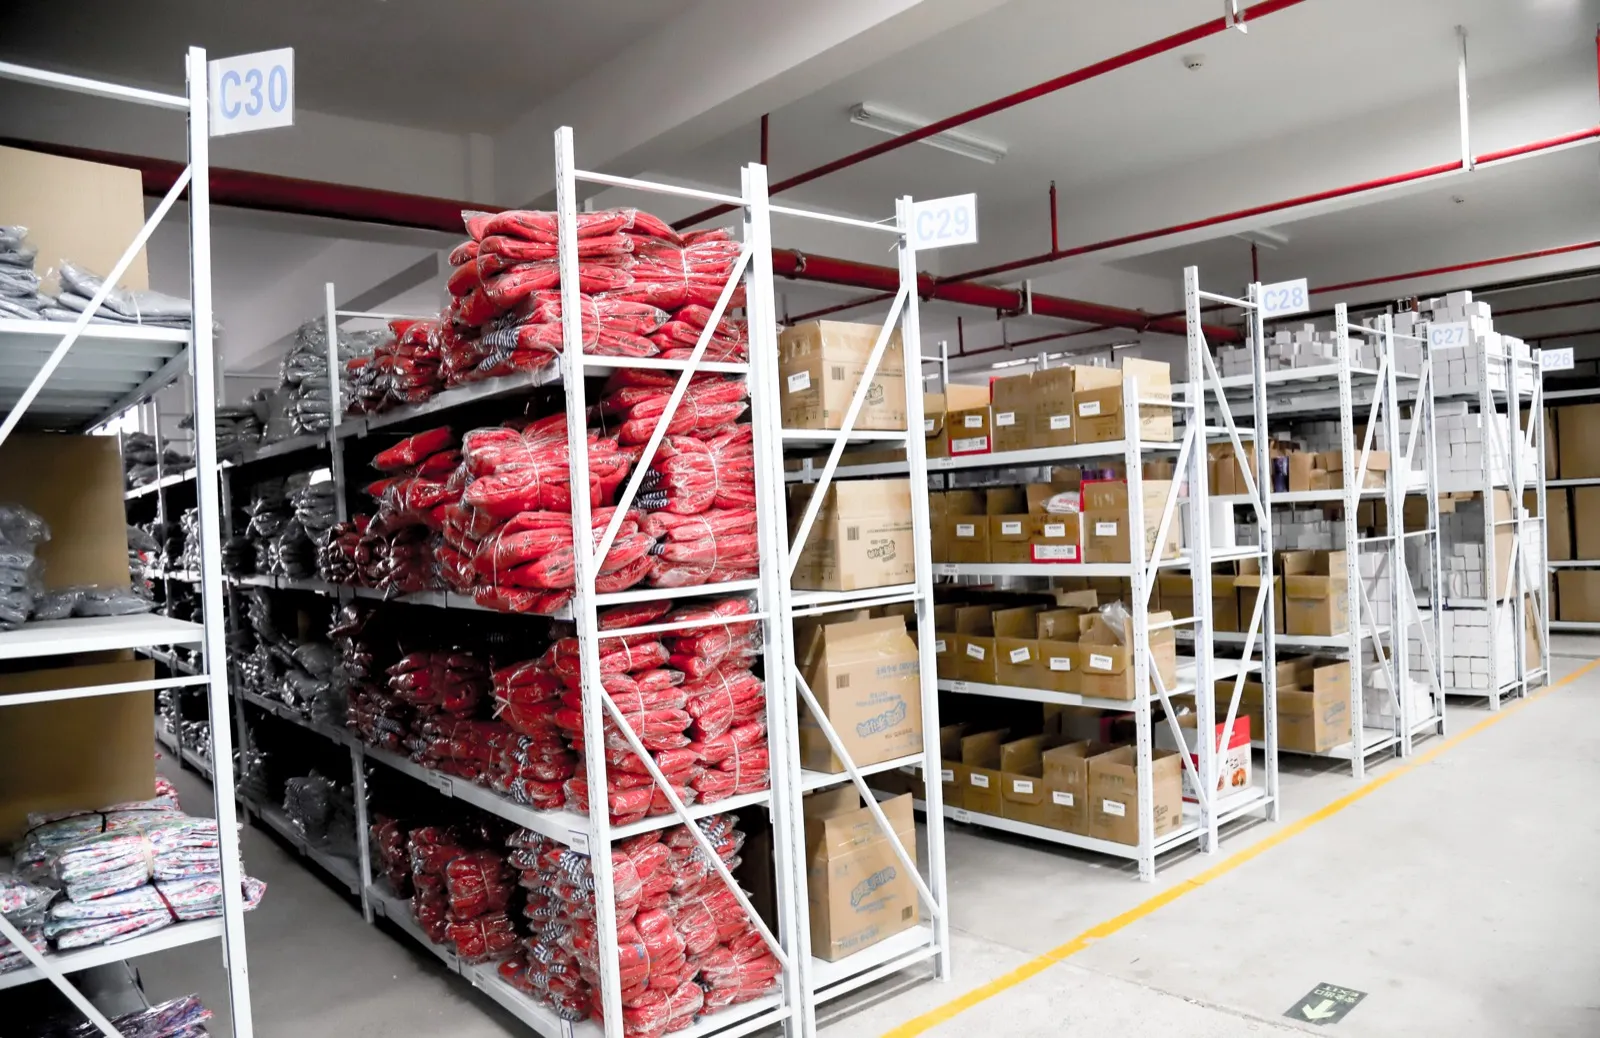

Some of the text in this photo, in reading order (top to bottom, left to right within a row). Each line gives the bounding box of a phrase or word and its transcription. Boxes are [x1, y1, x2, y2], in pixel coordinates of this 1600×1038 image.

[220, 64, 288, 119] C30
[916, 206, 970, 240] C29
[1263, 287, 1303, 311] C28
[1431, 327, 1464, 345] C27
[1542, 352, 1571, 367] C26
[1313, 989, 1358, 1003] 安全出口
[1322, 986, 1360, 997] EXIT
